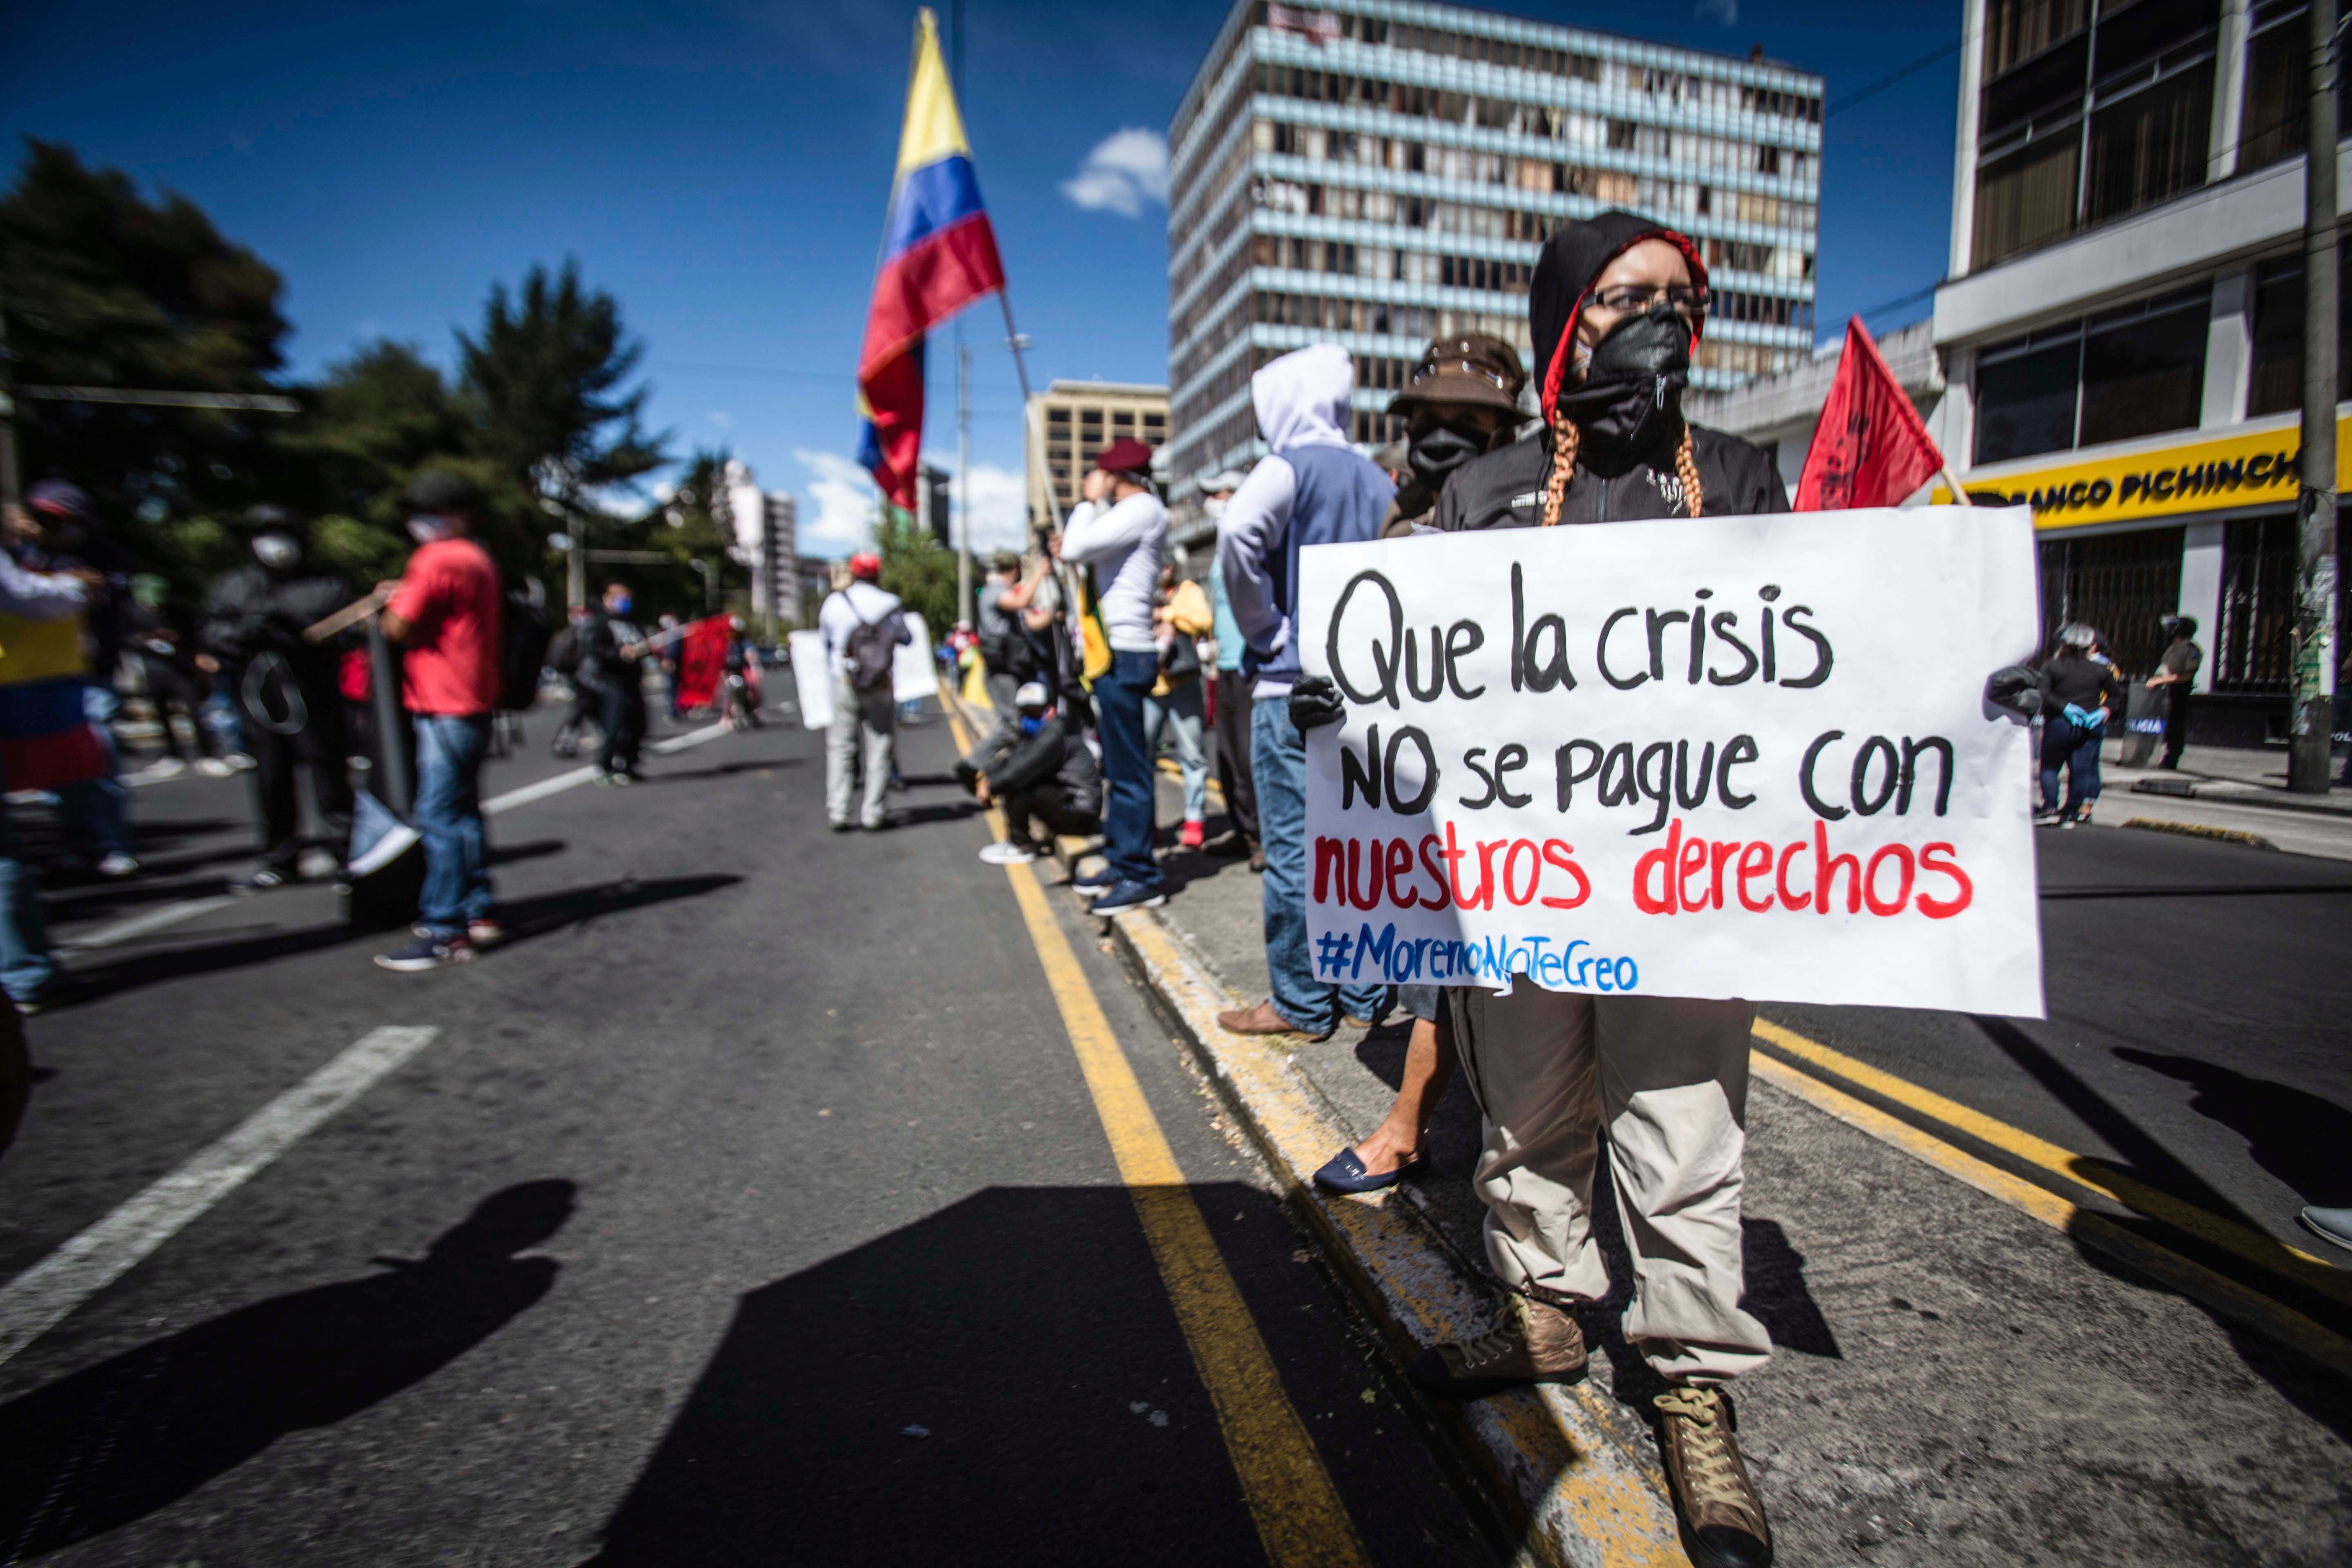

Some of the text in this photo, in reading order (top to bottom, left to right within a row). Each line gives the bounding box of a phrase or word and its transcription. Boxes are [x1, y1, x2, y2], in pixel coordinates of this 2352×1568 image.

[1326, 561, 1834, 710] Que la crisis
[1341, 724, 1953, 835] NO se pague con
[1314, 818, 1973, 919] nuestros derechos
[1316, 923, 1638, 991] #MorenoNoTeCreo
